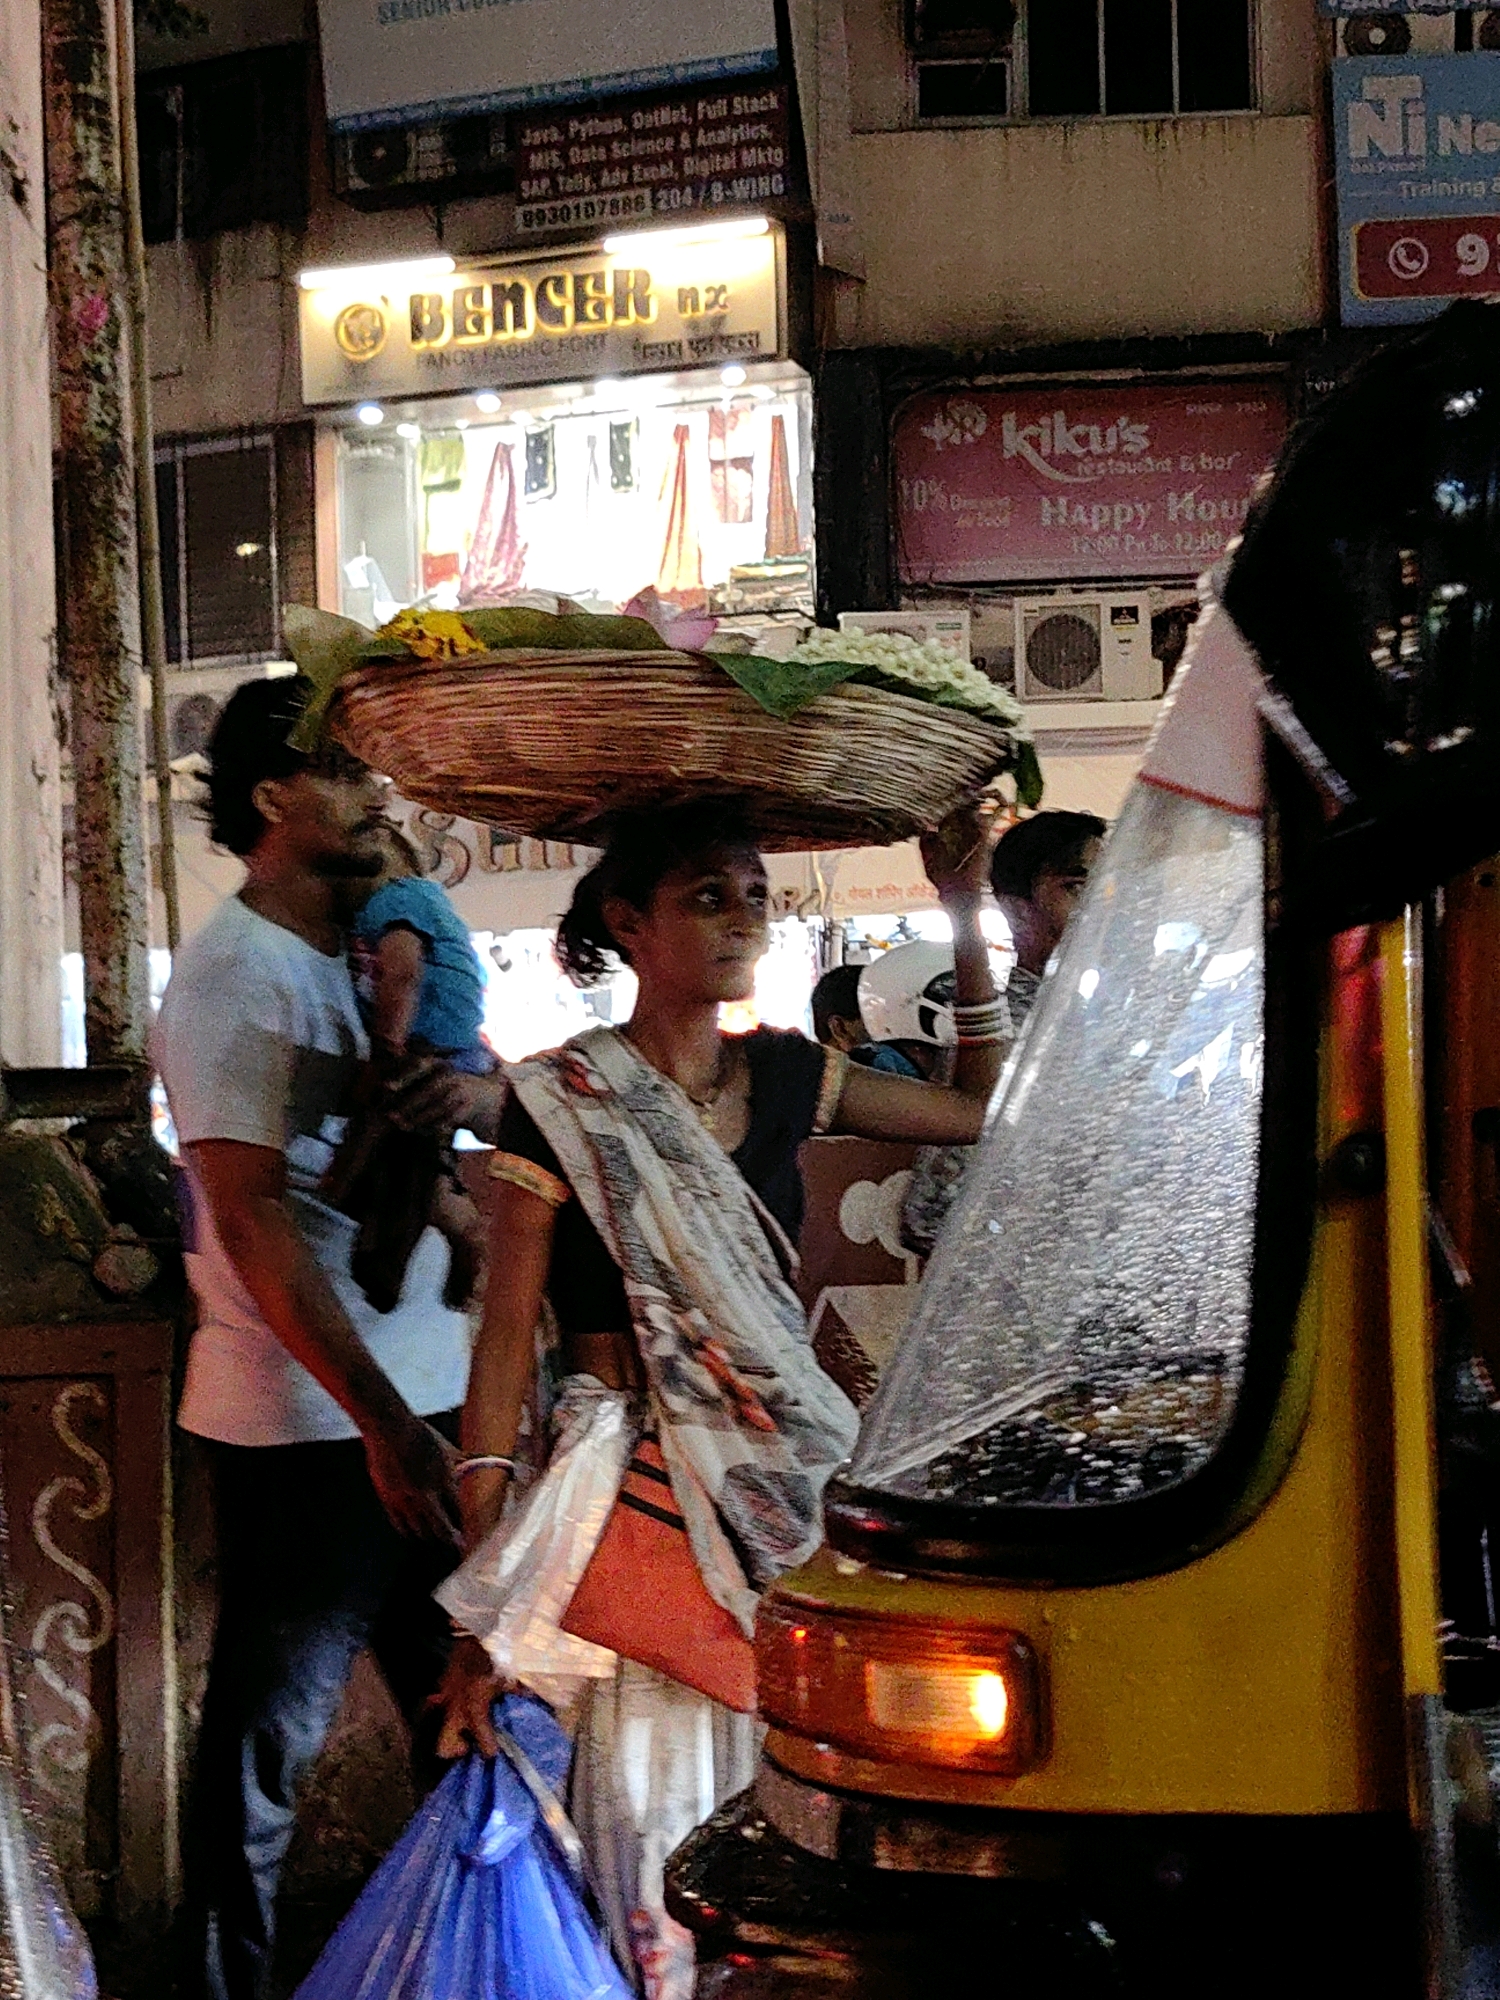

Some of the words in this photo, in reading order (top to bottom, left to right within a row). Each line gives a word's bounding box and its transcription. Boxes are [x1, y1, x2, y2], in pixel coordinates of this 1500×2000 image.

[697, 98, 727, 121] Full
[733, 90, 779, 116] Stack
[610, 137, 675, 159] Science
[680, 131, 691, 150] &
[1400, 178, 1486, 198] Training
